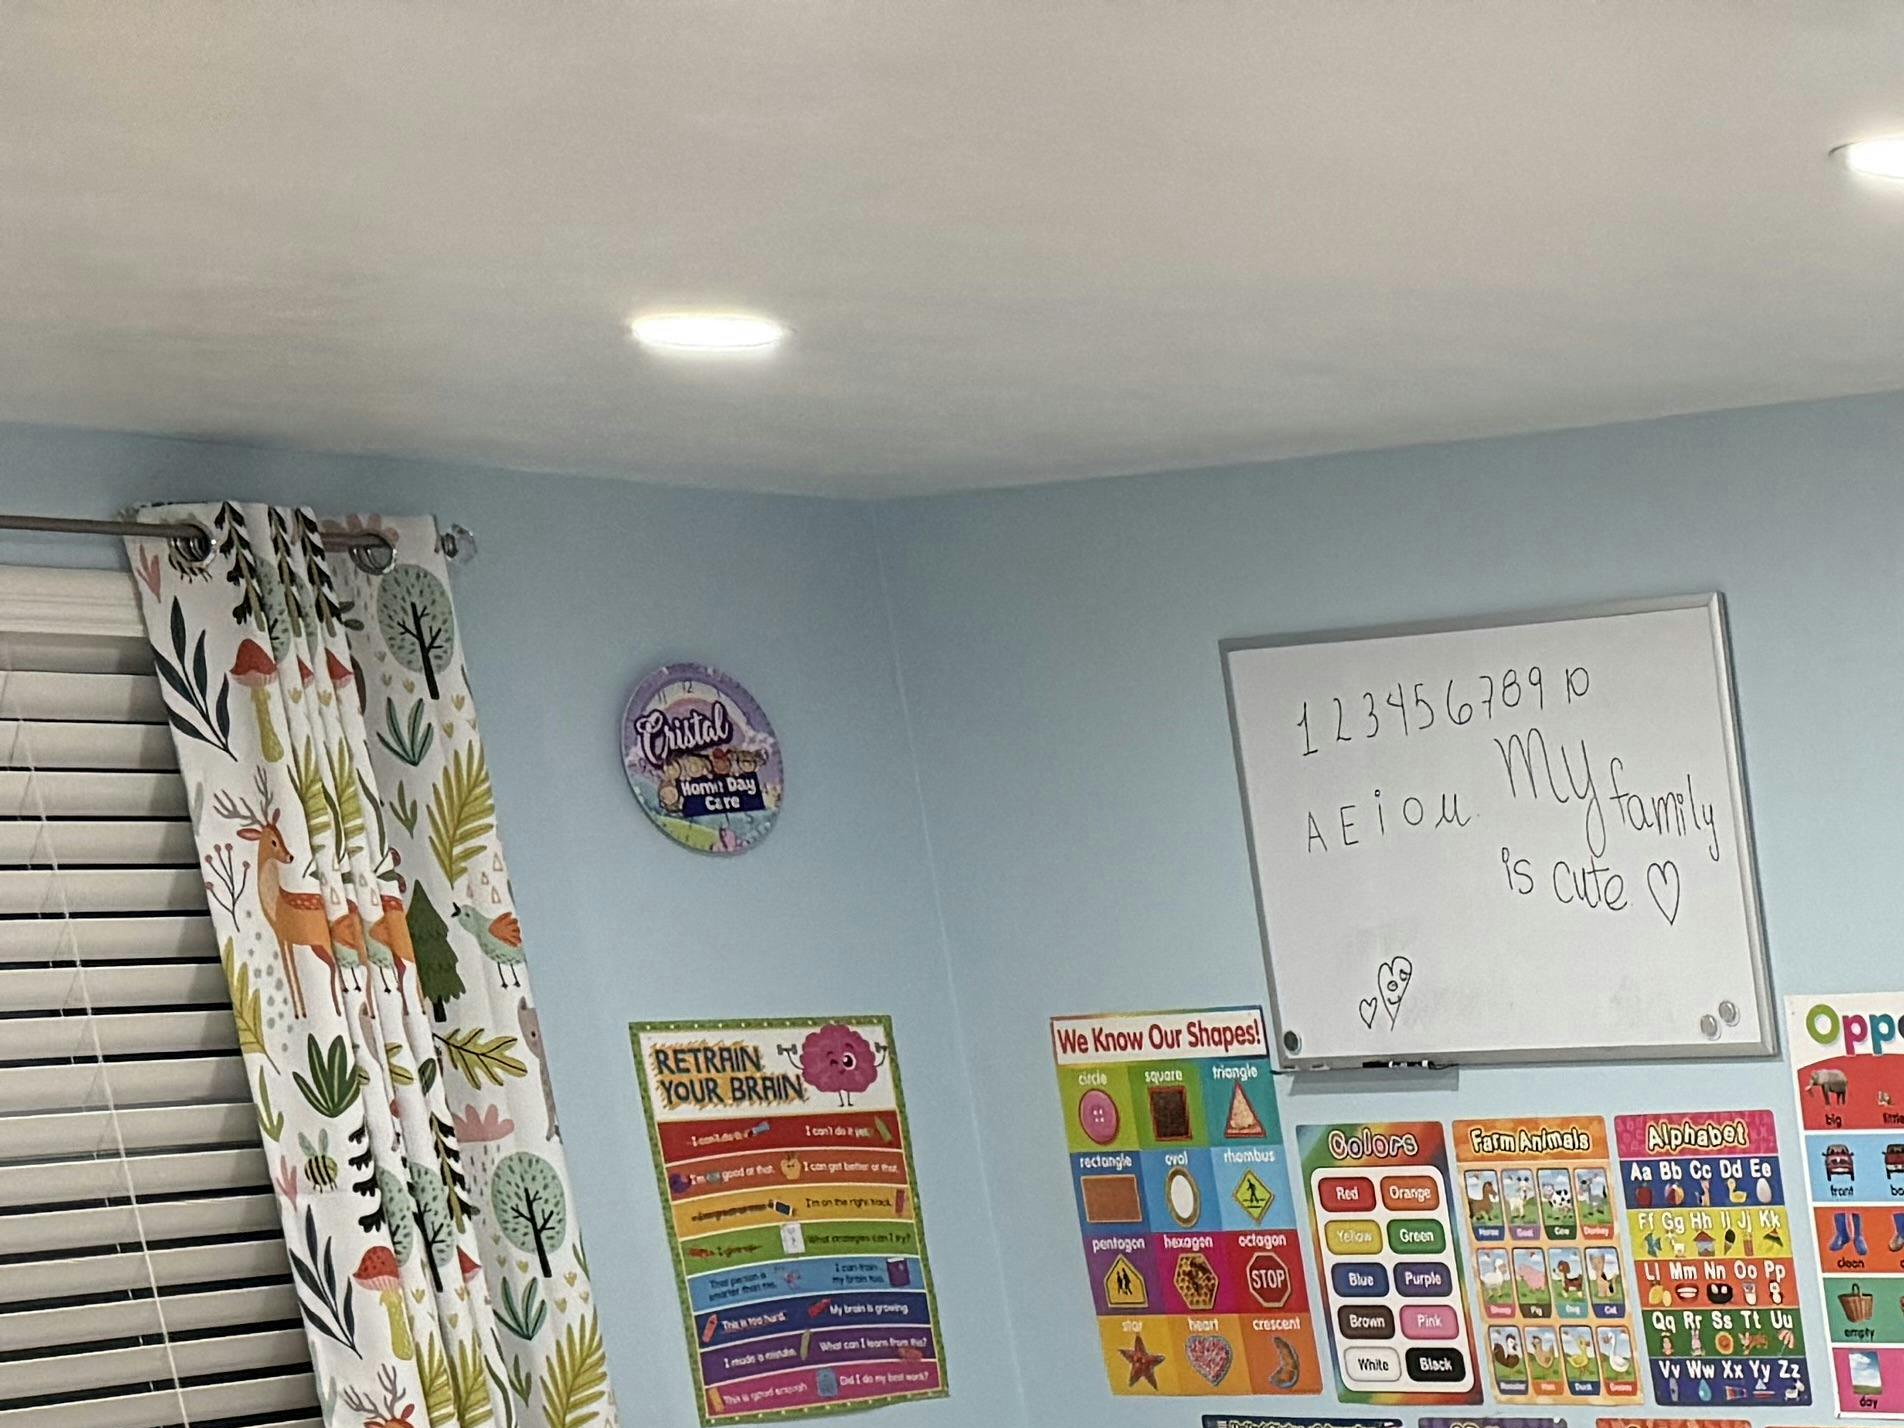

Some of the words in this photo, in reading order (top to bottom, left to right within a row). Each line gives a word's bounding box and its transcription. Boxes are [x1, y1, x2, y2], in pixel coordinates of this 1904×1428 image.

[635, 701, 733, 769] Cristal
[727, 775, 757, 795] Day
[1494, 728, 1606, 858] My
[1609, 758, 1719, 861] family
[705, 796, 740, 811] Care
[1501, 848, 1534, 894] is
[1552, 856, 1628, 910] cute
[1057, 1029, 1089, 1054] We
[1093, 1027, 1143, 1052] Know
[1149, 1023, 1182, 1050] Our
[1186, 1018, 1261, 1054] Shapes!
[654, 1045, 764, 1076] RETRAIN
[1078, 1070, 1107, 1085] circle
[1144, 1068, 1183, 1084] square
[1212, 1064, 1258, 1081] triangle
[659, 1078, 725, 1105] YOUR
[730, 1073, 805, 1102] BRAIN
[1825, 1113, 1842, 1127] big
[1328, 1128, 1418, 1160] Colors
[1471, 1128, 1515, 1153] Farm
[1518, 1128, 1590, 1152] Animals
[1648, 1121, 1747, 1151] Alphabet
[1079, 1154, 1132, 1170] rectangle
[1165, 1151, 1188, 1165] oval
[1223, 1149, 1275, 1163] rhombus
[1630, 1162, 1652, 1181] Aa
[1659, 1161, 1682, 1180] Bb
[1689, 1160, 1712, 1179] Cc
[1720, 1159, 1743, 1179] Dd
[1750, 1158, 1772, 1177] Ee
[1336, 1187, 1359, 1201] Red
[1389, 1186, 1431, 1202] Orange
[1163, 1234, 1213, 1251] hexagon
[1238, 1234, 1287, 1249] octagon
[1336, 1229, 1373, 1243] Yellow
[1399, 1228, 1434, 1243] Green
[1092, 1237, 1145, 1253] pentagon
[1251, 1269, 1286, 1289] STOP
[1348, 1273, 1374, 1286] Blue
[1405, 1272, 1441, 1288] Purple
[1252, 1317, 1301, 1331] crescent
[1350, 1314, 1385, 1328] Brown
[1417, 1314, 1442, 1328] Pink
[1358, 1358, 1389, 1371] White
[1419, 1357, 1452, 1371] Black
